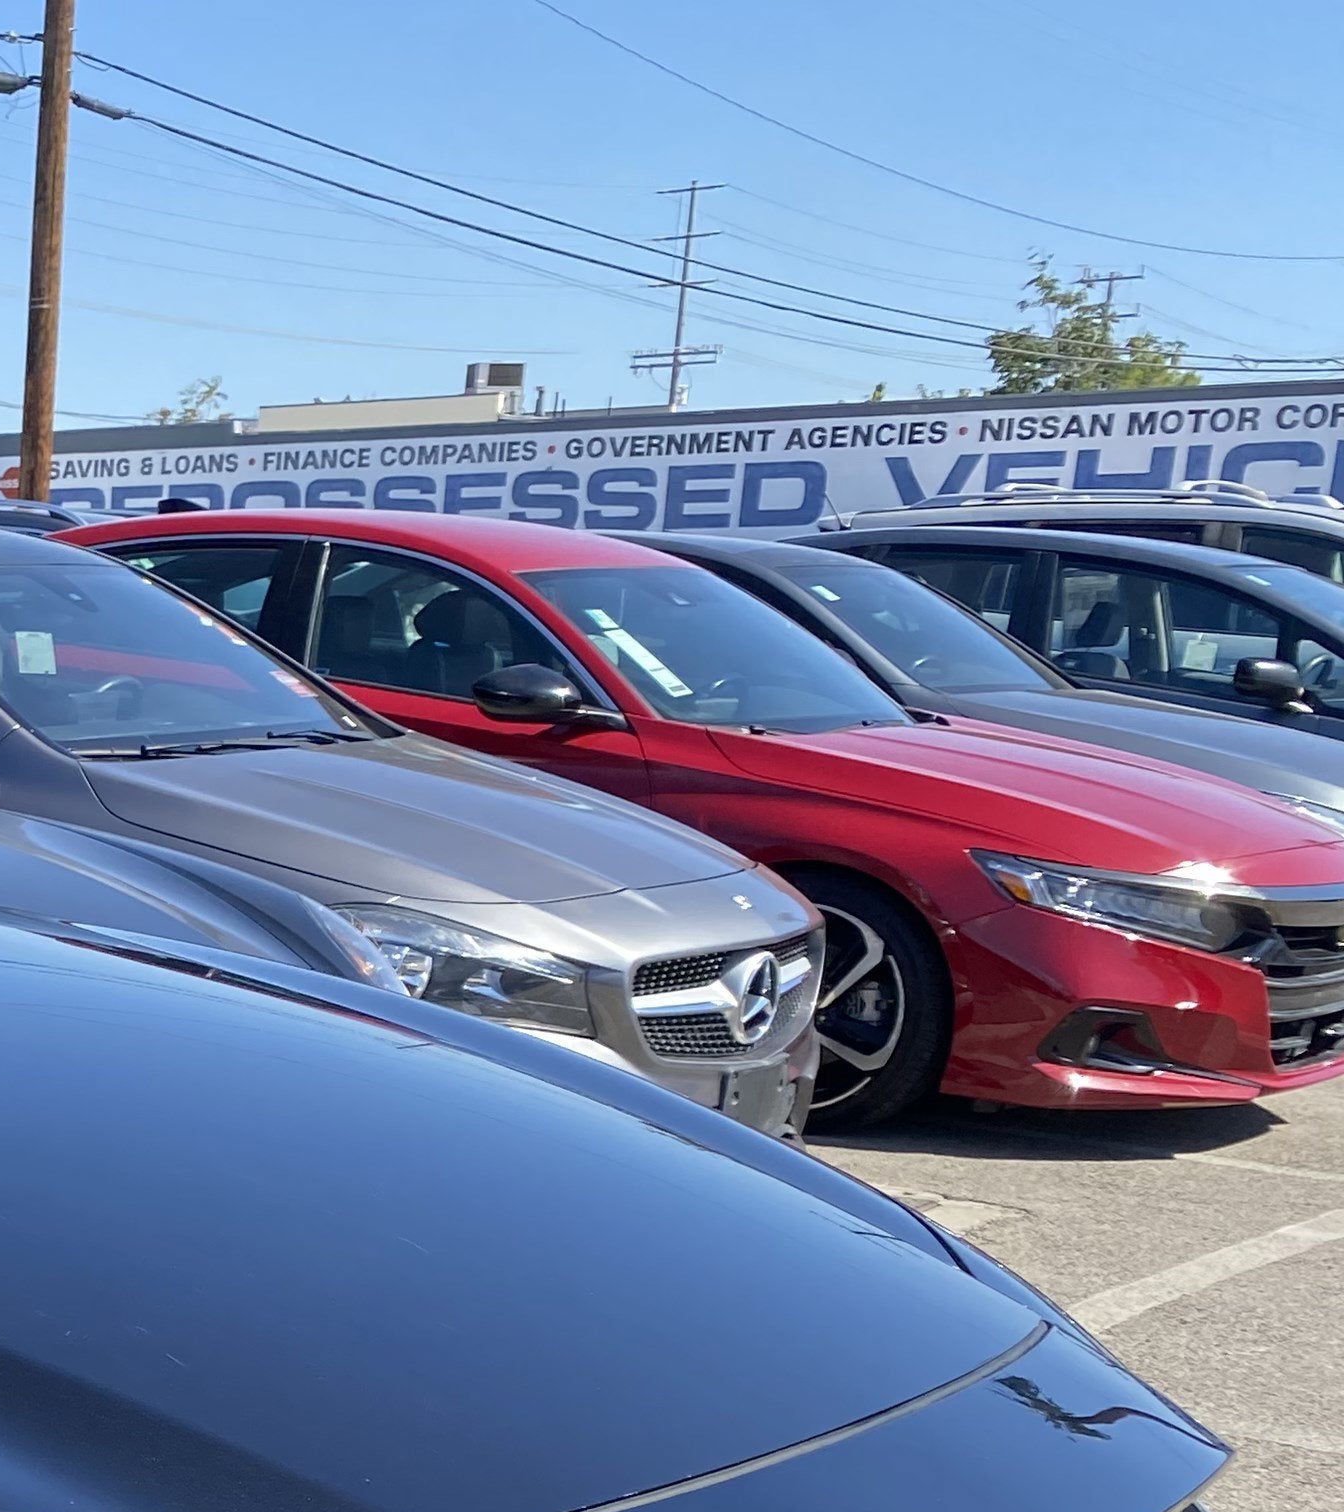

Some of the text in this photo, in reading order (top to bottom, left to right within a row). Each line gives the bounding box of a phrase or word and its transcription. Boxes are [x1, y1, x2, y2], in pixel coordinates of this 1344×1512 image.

[50, 457, 130, 480] SAVING
[140, 456, 154, 475] &
[161, 452, 239, 475] LOANS
[262, 447, 372, 472] FINANCE
[380, 440, 538, 467] COMPANIES
[565, 429, 776, 460] GOVERNMENT
[784, 420, 949, 451] AGENCIES
[979, 412, 1115, 443] NISSAN
[1127, 406, 1261, 437] MOTOR
[885, 439, 1344, 507] VEHIC
